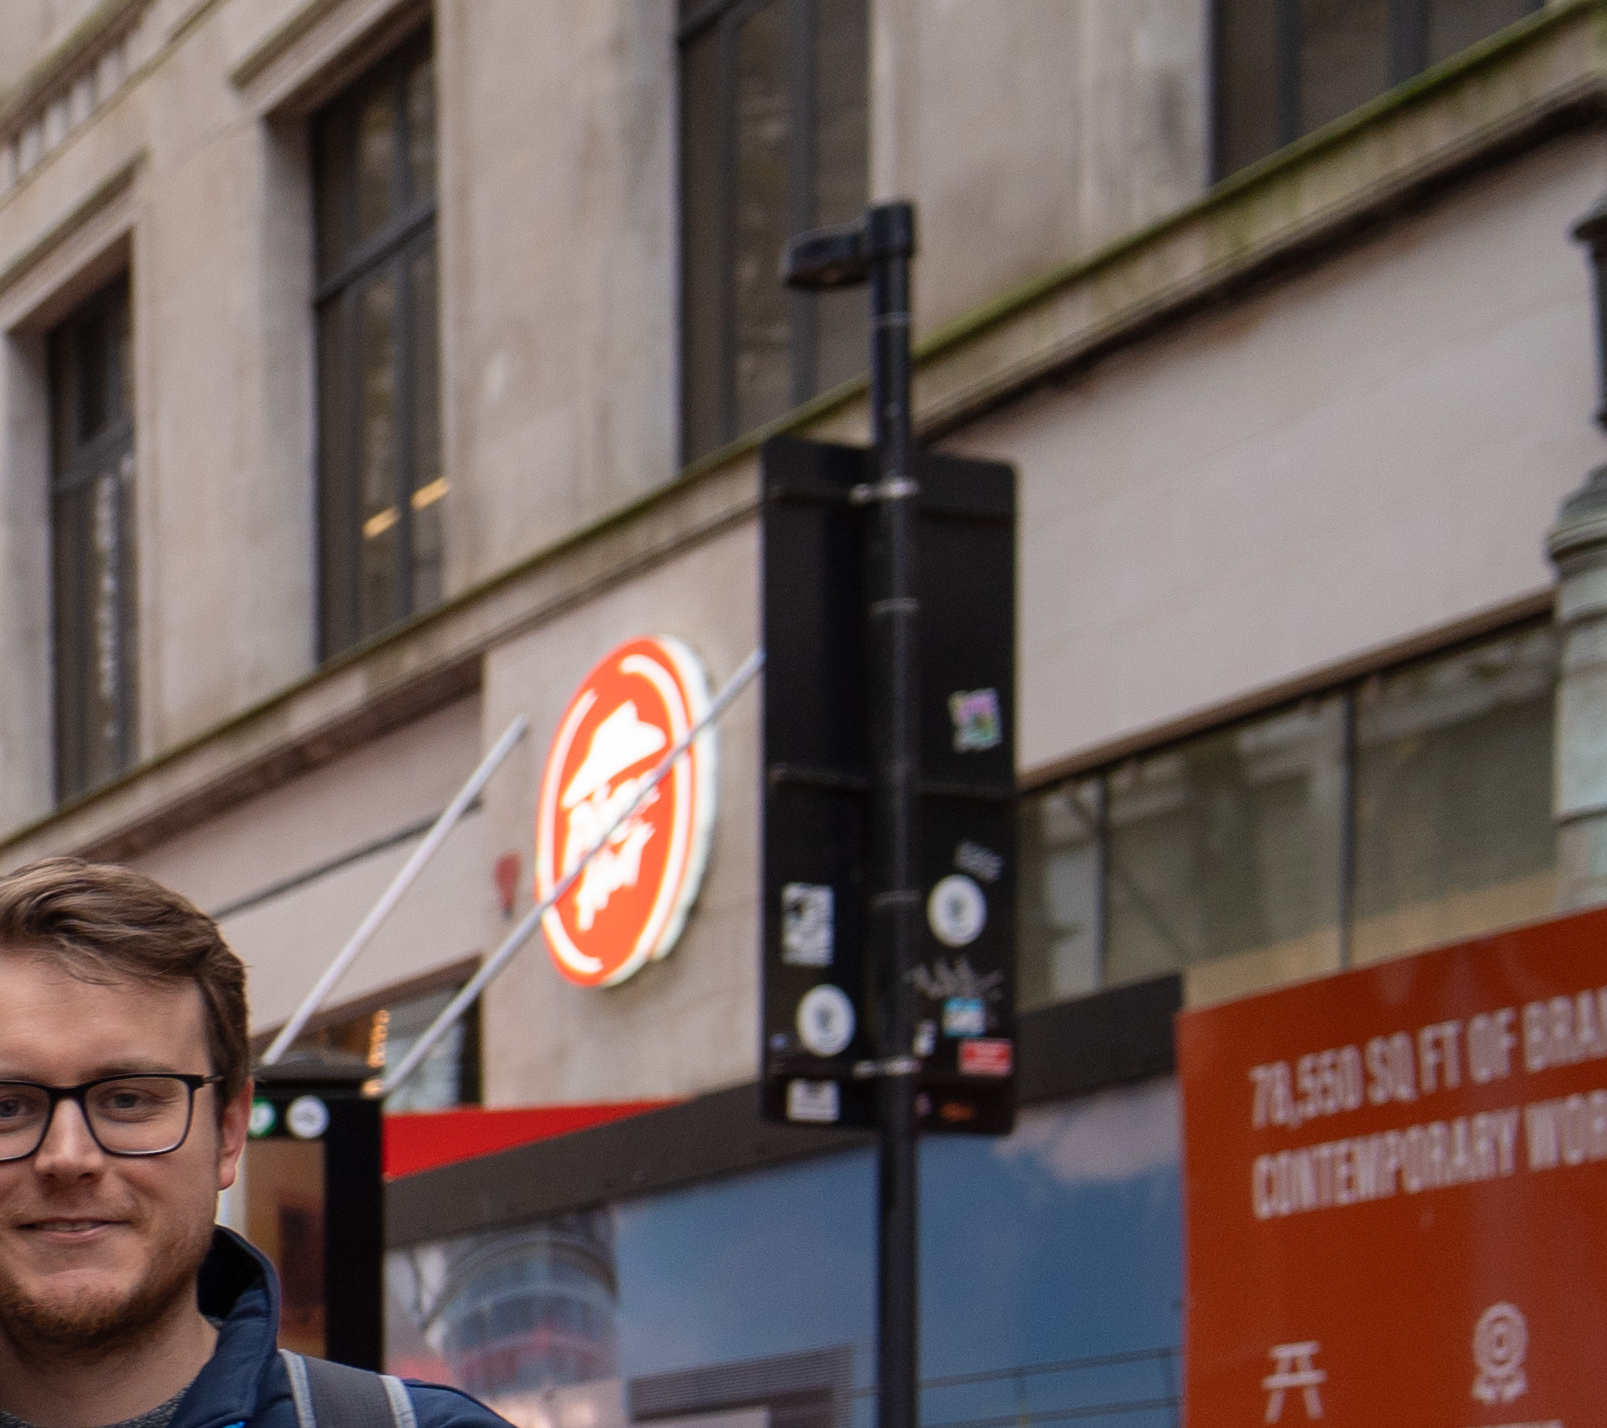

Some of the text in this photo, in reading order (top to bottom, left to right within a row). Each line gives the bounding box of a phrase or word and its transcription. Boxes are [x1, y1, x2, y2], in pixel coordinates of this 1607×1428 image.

[1418, 1019, 1463, 1096] FT
[1467, 1007, 1518, 1085] OF
[1252, 1105, 1521, 1221] CONTEMPORARY
